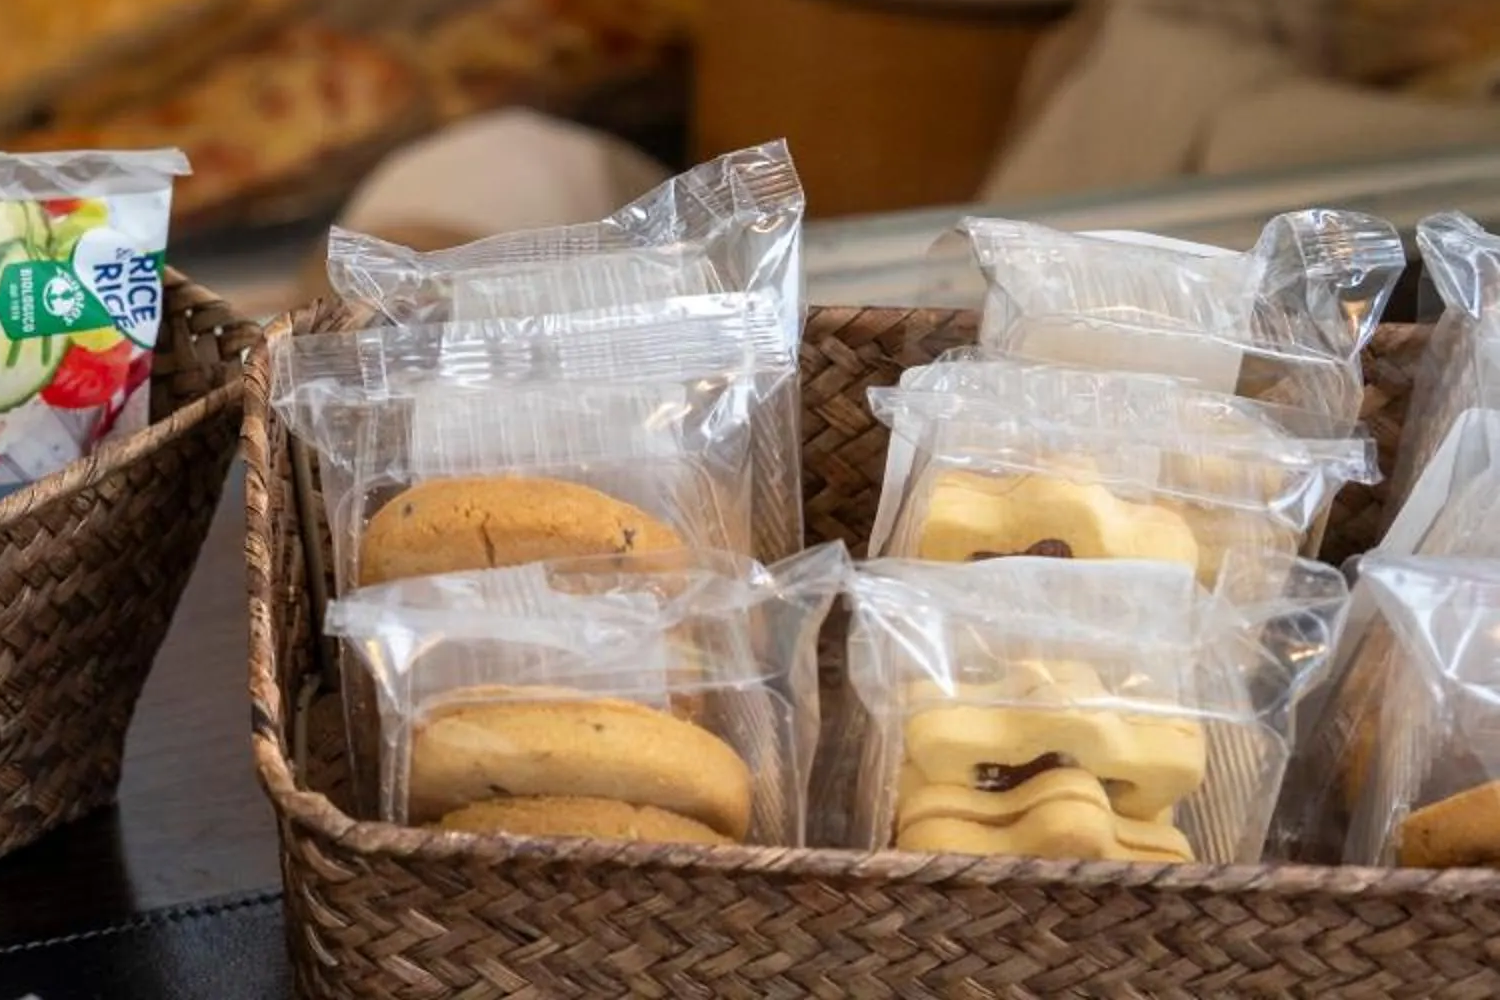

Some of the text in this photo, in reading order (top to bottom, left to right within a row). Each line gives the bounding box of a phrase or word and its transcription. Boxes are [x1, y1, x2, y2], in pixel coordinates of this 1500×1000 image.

[19, 267, 36, 333] BIOLOGICO
[93, 263, 135, 332] RICE
[128, 255, 159, 325] RICE
